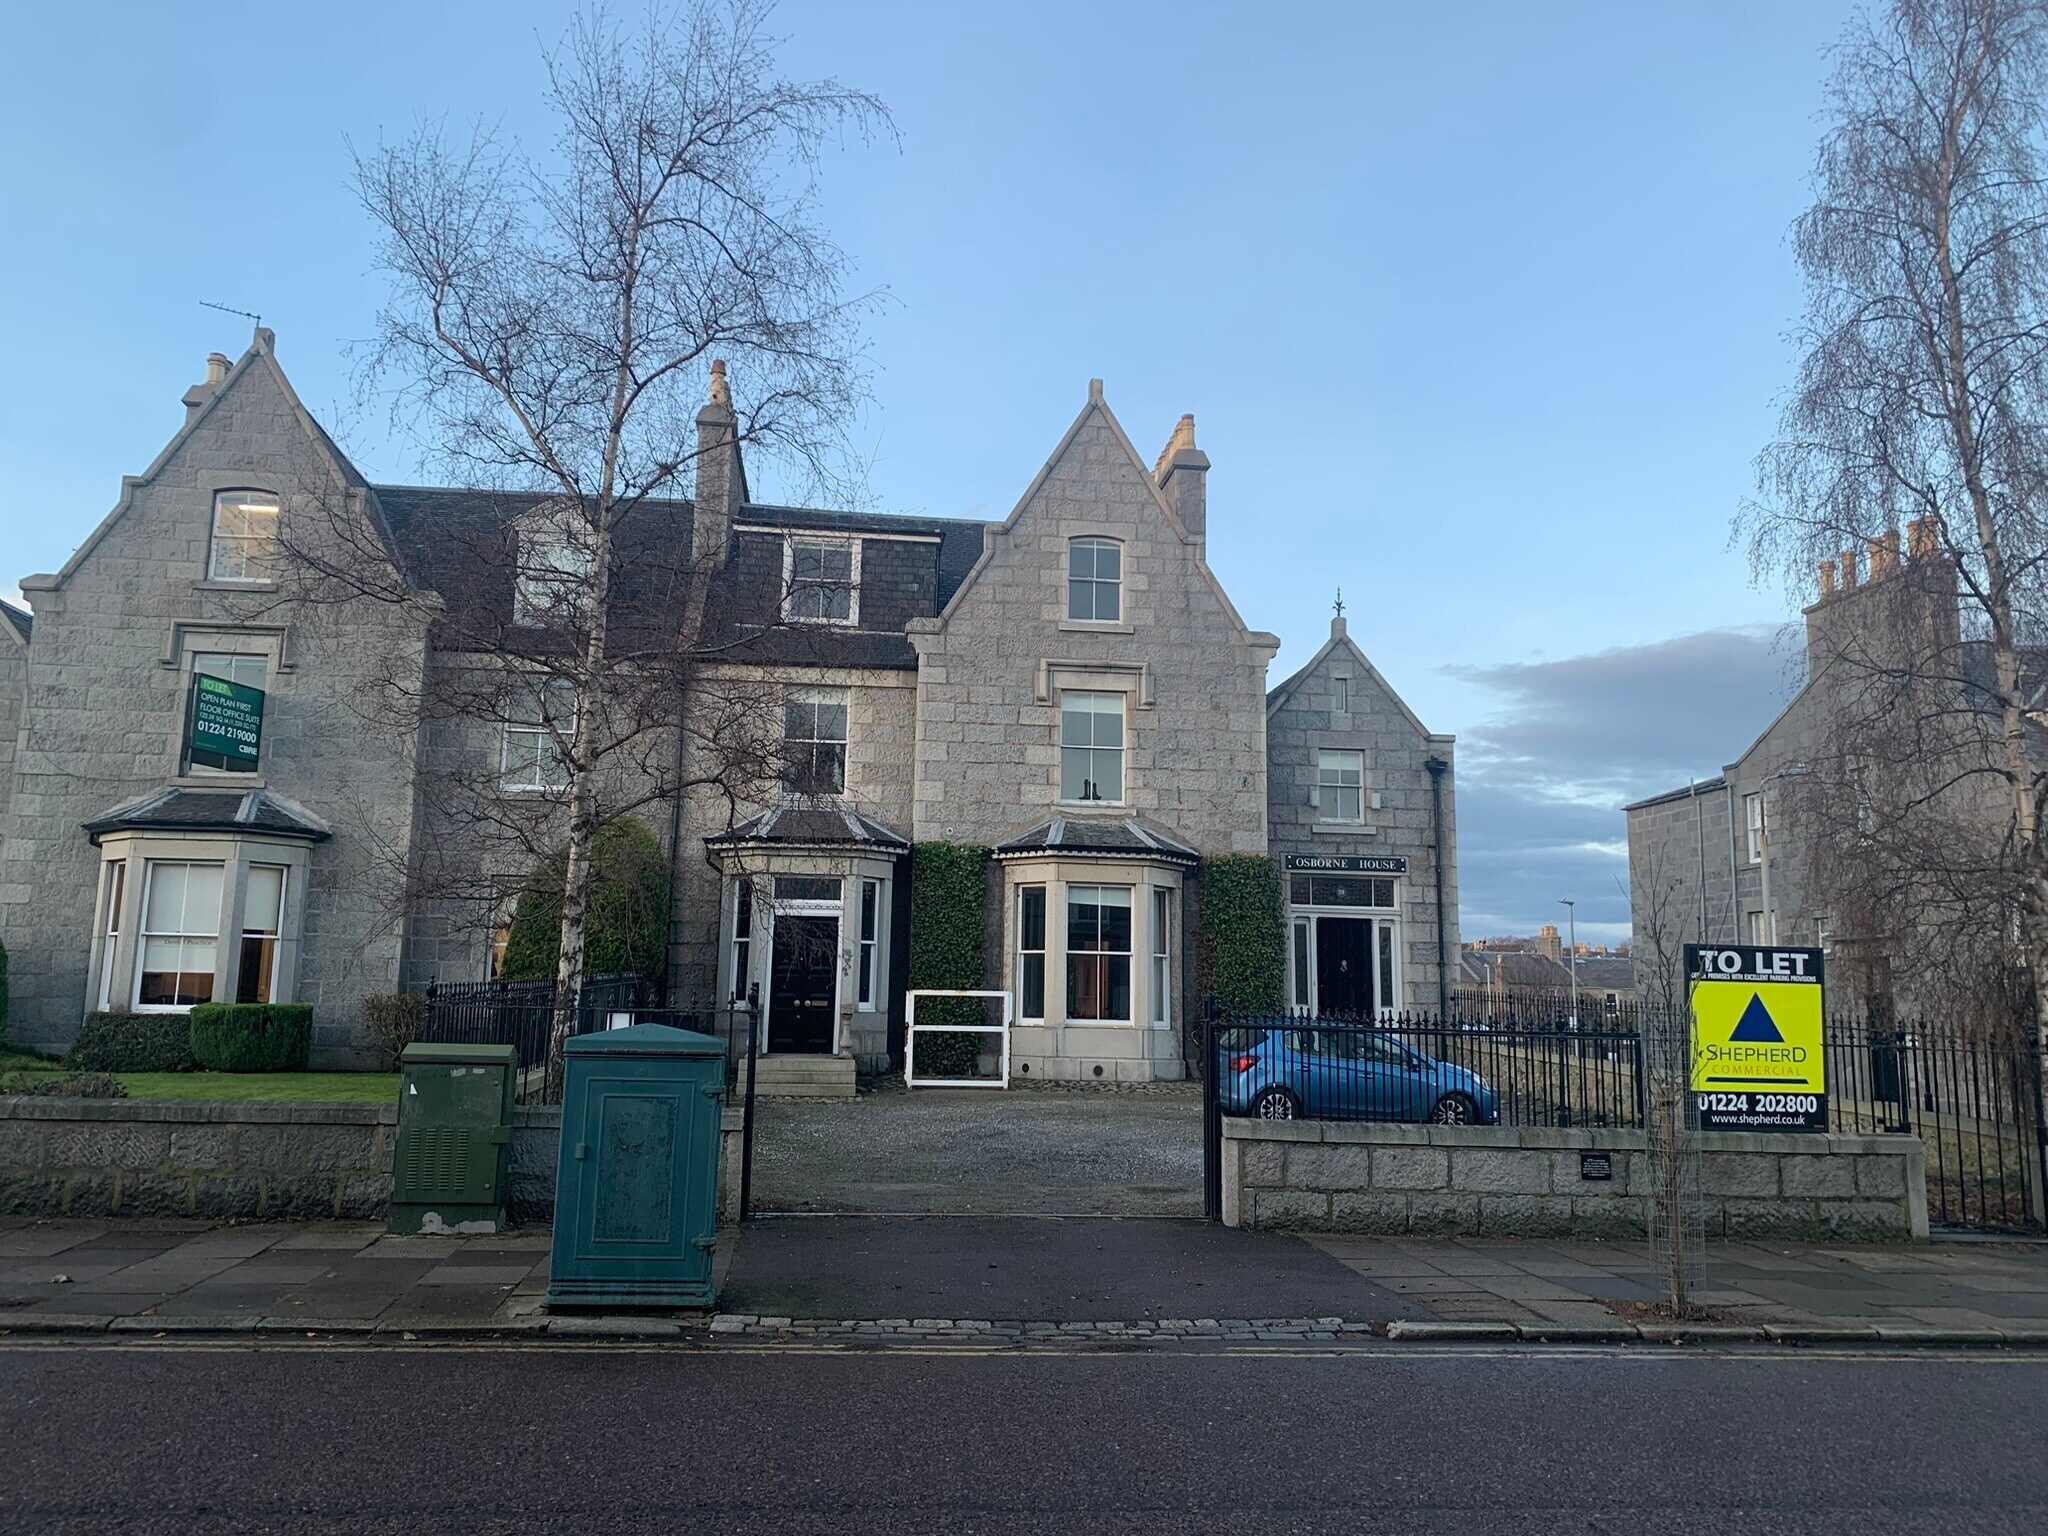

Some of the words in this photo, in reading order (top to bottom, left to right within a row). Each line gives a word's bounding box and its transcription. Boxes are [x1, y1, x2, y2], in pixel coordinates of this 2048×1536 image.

[203, 680, 214, 690] TO
[215, 682, 226, 693] LET
[201, 692, 218, 703] OPEN
[220, 697, 235, 708] PLAN
[236, 701, 251, 712] FIRST
[200, 702, 221, 714] FLOOR
[222, 708, 244, 720] OFFICE
[245, 714, 260, 724] SUITE
[198, 720, 226, 736] 01224
[226, 727, 256, 743] 219000
[238, 744, 258, 756] CBRE
[1295, 857, 1348, 869] OSBORNE
[1359, 860, 1397, 870] HOUSE
[1699, 950, 1742, 974] TO
[1755, 952, 1809, 976] LET
[1708, 972, 1730, 980] PREMISES
[1706, 1044, 1806, 1063] SHEPHERD
[1712, 1065, 1802, 1076] COMMERCIAL
[1699, 1094, 1748, 1111] 01224
[1755, 1095, 1817, 1113] 202800
[1711, 1113, 1805, 1126] www.shepherd.co.uk
